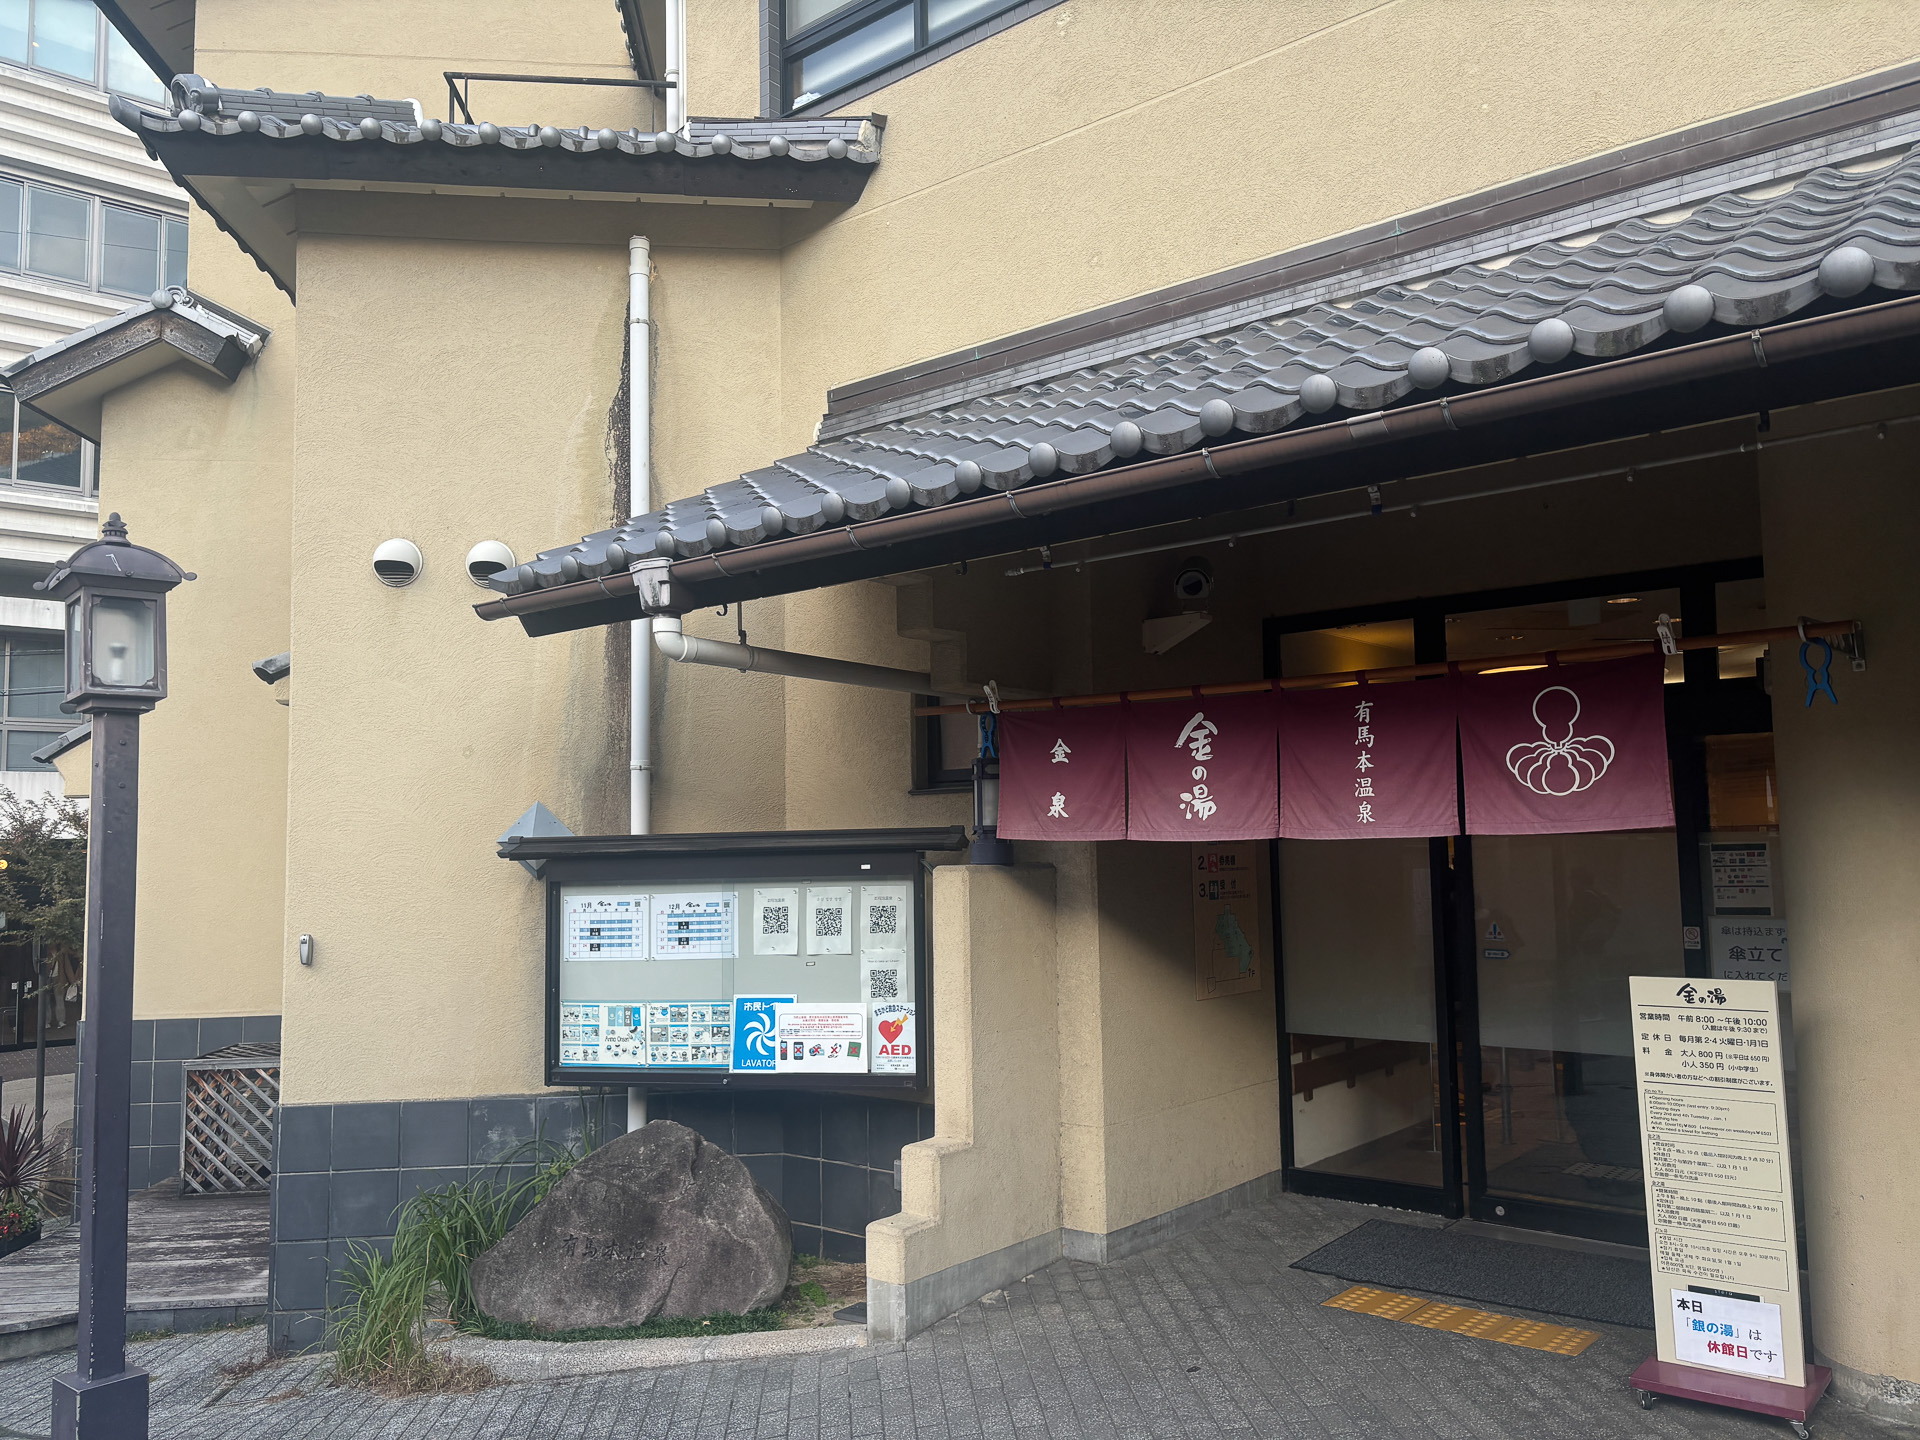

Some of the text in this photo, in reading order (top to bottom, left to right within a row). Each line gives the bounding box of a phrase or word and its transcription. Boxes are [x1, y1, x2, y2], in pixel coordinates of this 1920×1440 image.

[1174, 712, 1218, 822] 金の湯
[1353, 700, 1376, 825] 有馬本温泉
[1728, 945, 1783, 962] 傘立て
[1676, 982, 1727, 1006] 金の湯
[1639, 1012, 1670, 1021] 営業時間
[878, 1044, 912, 1055] AED
[1676, 1297, 1703, 1314] 本日
[1707, 1340, 1778, 1363] 休館日です
